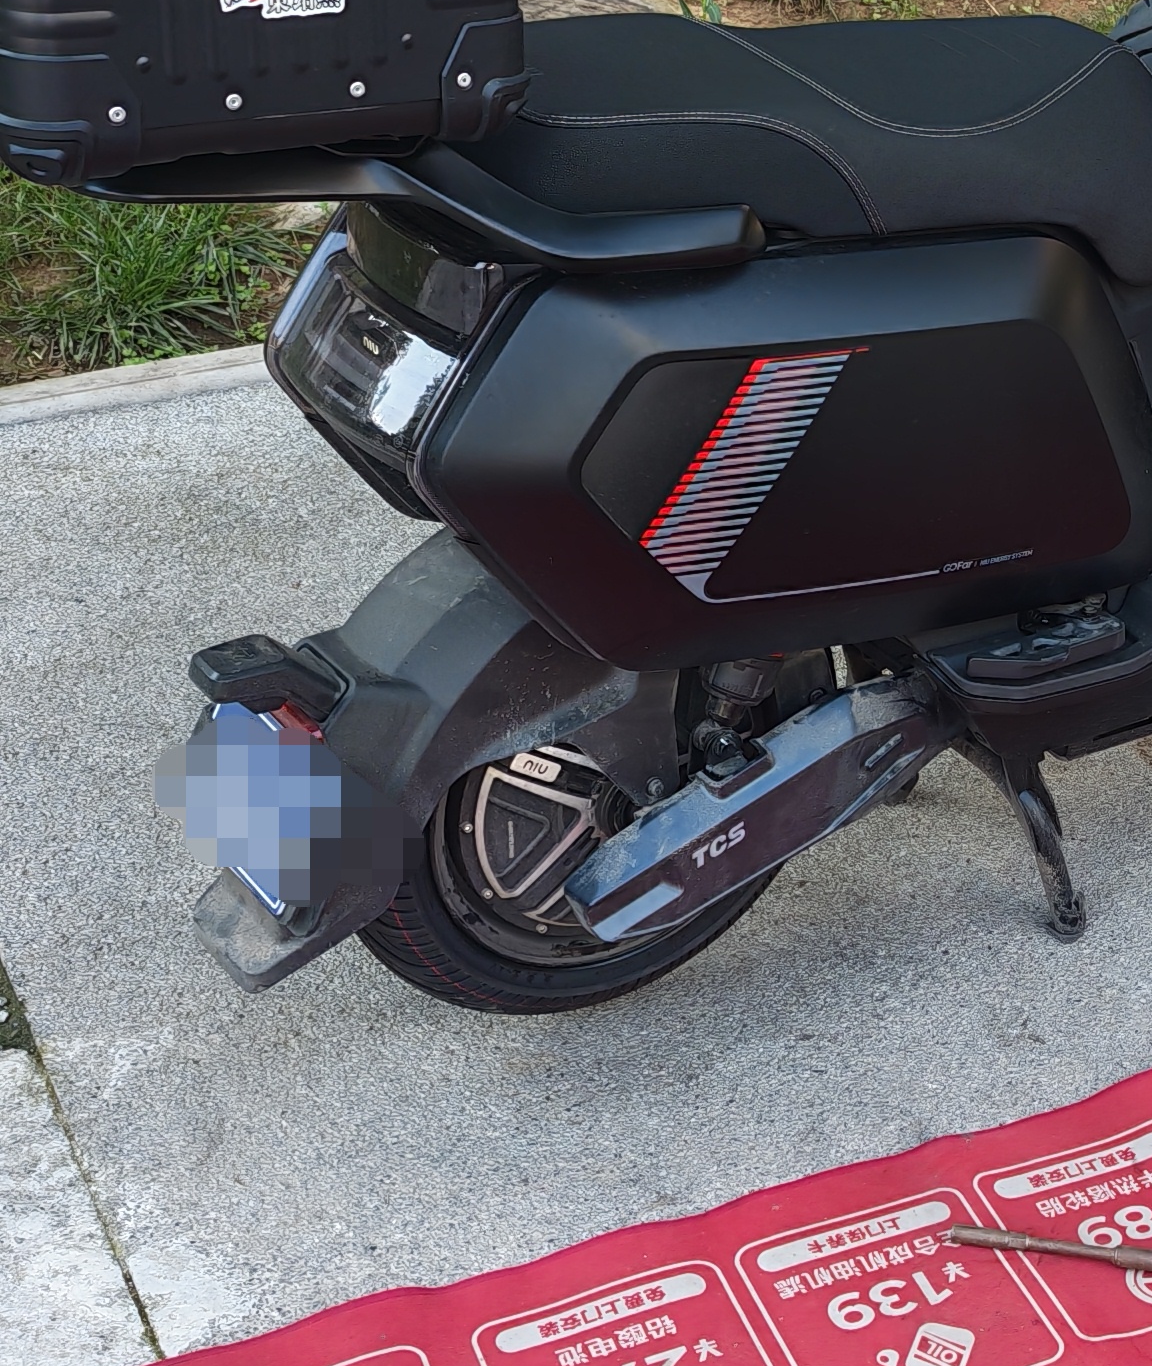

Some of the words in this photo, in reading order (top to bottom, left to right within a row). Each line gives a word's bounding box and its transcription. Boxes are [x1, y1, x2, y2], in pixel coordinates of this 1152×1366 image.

[691, 821, 746, 868] TCS
[1027, 1147, 1136, 1188] 免费上门安装
[807, 1217, 900, 1254] 上门保养卡
[537, 1286, 666, 1338] 免费上门安装
[927, 1340, 958, 1364] OIL
